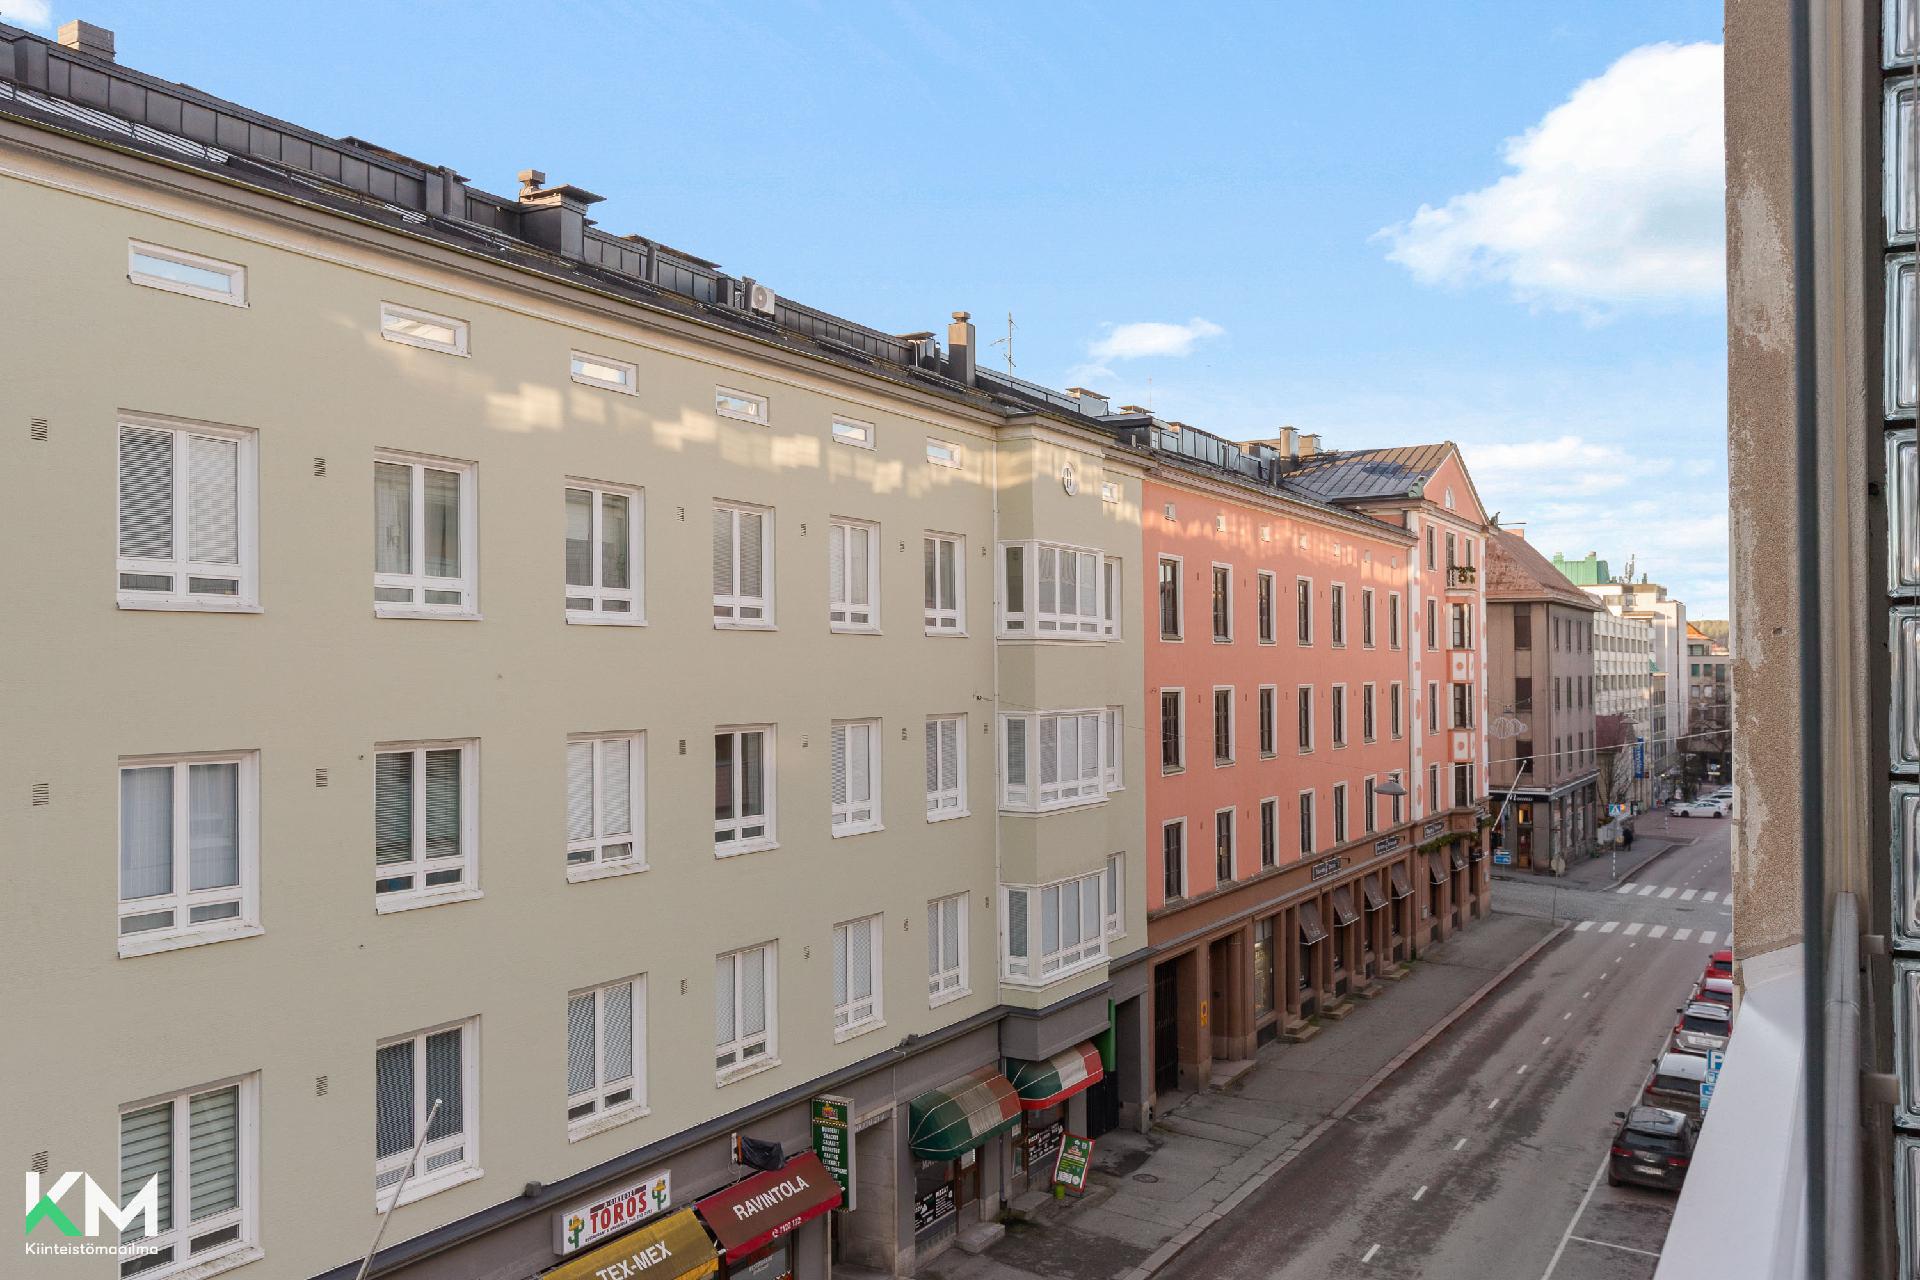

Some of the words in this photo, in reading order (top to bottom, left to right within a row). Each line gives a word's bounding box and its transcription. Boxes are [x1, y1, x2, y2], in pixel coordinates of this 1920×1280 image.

[590, 1191, 647, 1234] TOROS
[732, 1175, 810, 1221] RAVINTOLA
[595, 1239, 672, 1280] TEX-MEX
